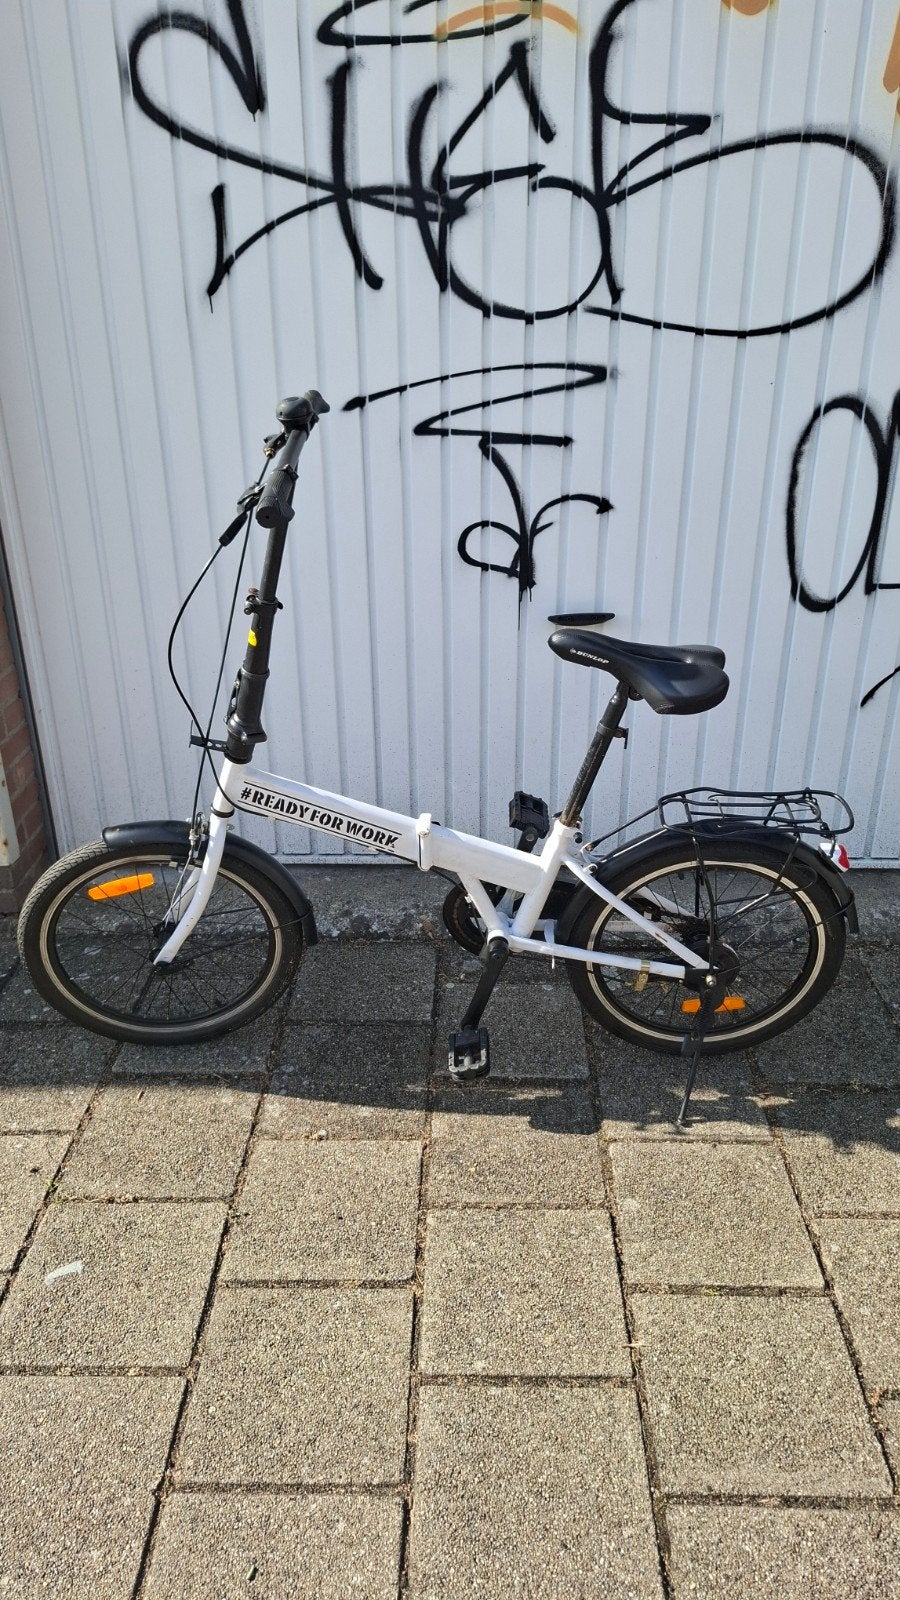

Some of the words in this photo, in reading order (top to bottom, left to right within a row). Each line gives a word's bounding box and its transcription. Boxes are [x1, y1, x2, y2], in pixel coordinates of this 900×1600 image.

[577, 651, 609, 663] DUNLOP
[241, 787, 309, 818] #READY
[310, 811, 344, 831] FOR
[346, 820, 398, 848] WORK
